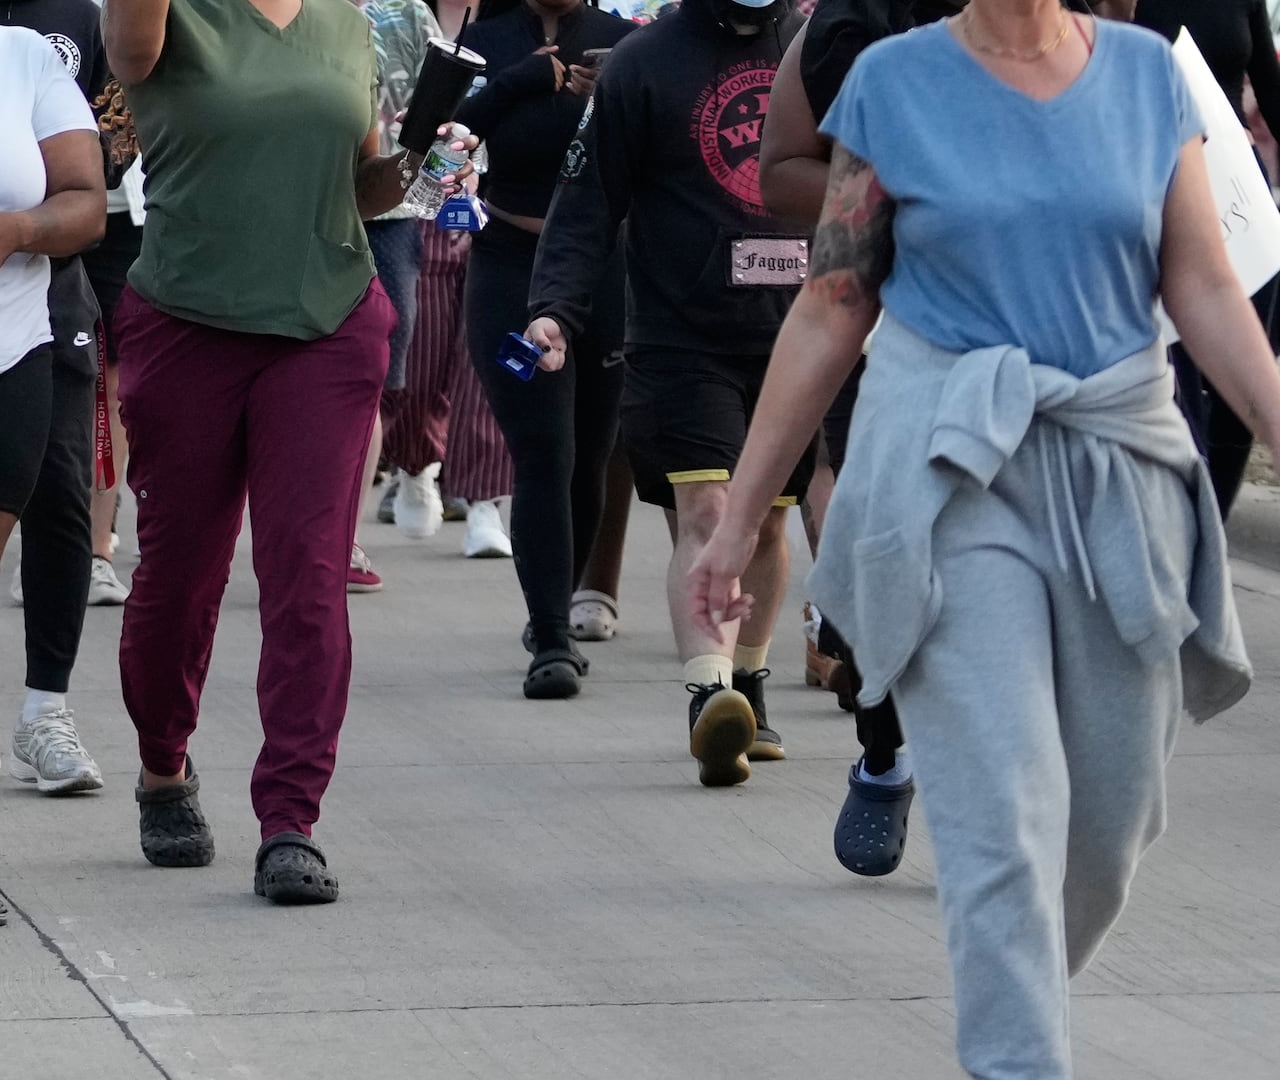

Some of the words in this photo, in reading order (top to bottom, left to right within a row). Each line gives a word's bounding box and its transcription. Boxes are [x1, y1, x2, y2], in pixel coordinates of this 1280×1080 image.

[692, 84, 715, 118] INJURY
[728, 60, 753, 75] ONE
[756, 59, 767, 68] IS
[702, 100, 729, 181] INDUSTRIAL
[741, 253, 800, 271] Faggot
[97, 331, 105, 392] MADISON
[96, 401, 106, 460] HOUSING
